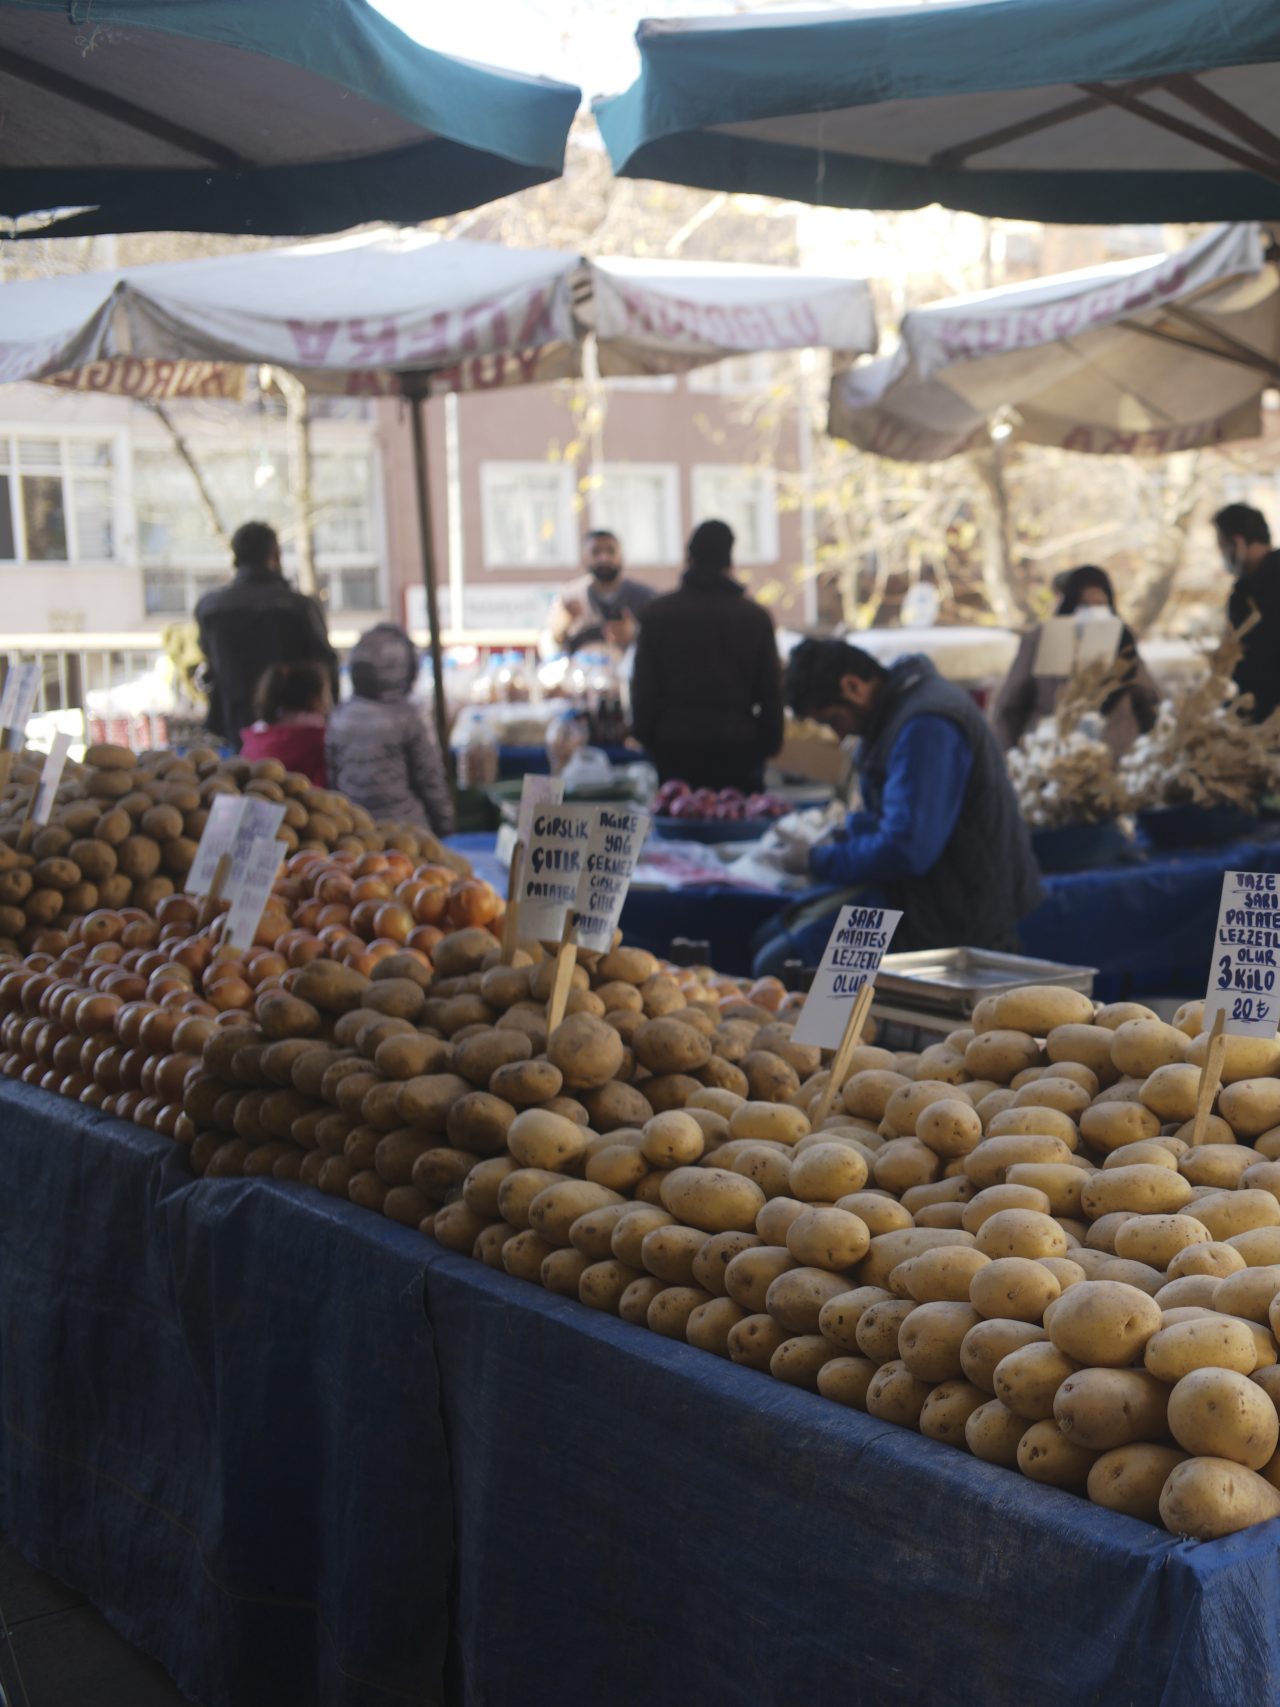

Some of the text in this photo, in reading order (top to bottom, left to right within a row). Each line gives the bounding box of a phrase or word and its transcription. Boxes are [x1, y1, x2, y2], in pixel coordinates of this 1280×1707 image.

[1235, 873, 1276, 891] TAZE
[1243, 893, 1279, 909] SARI
[848, 908, 884, 929] SARI
[836, 929, 887, 948] PATATES
[1238, 948, 1277, 966] OLUR
[1218, 955, 1233, 988] 3
